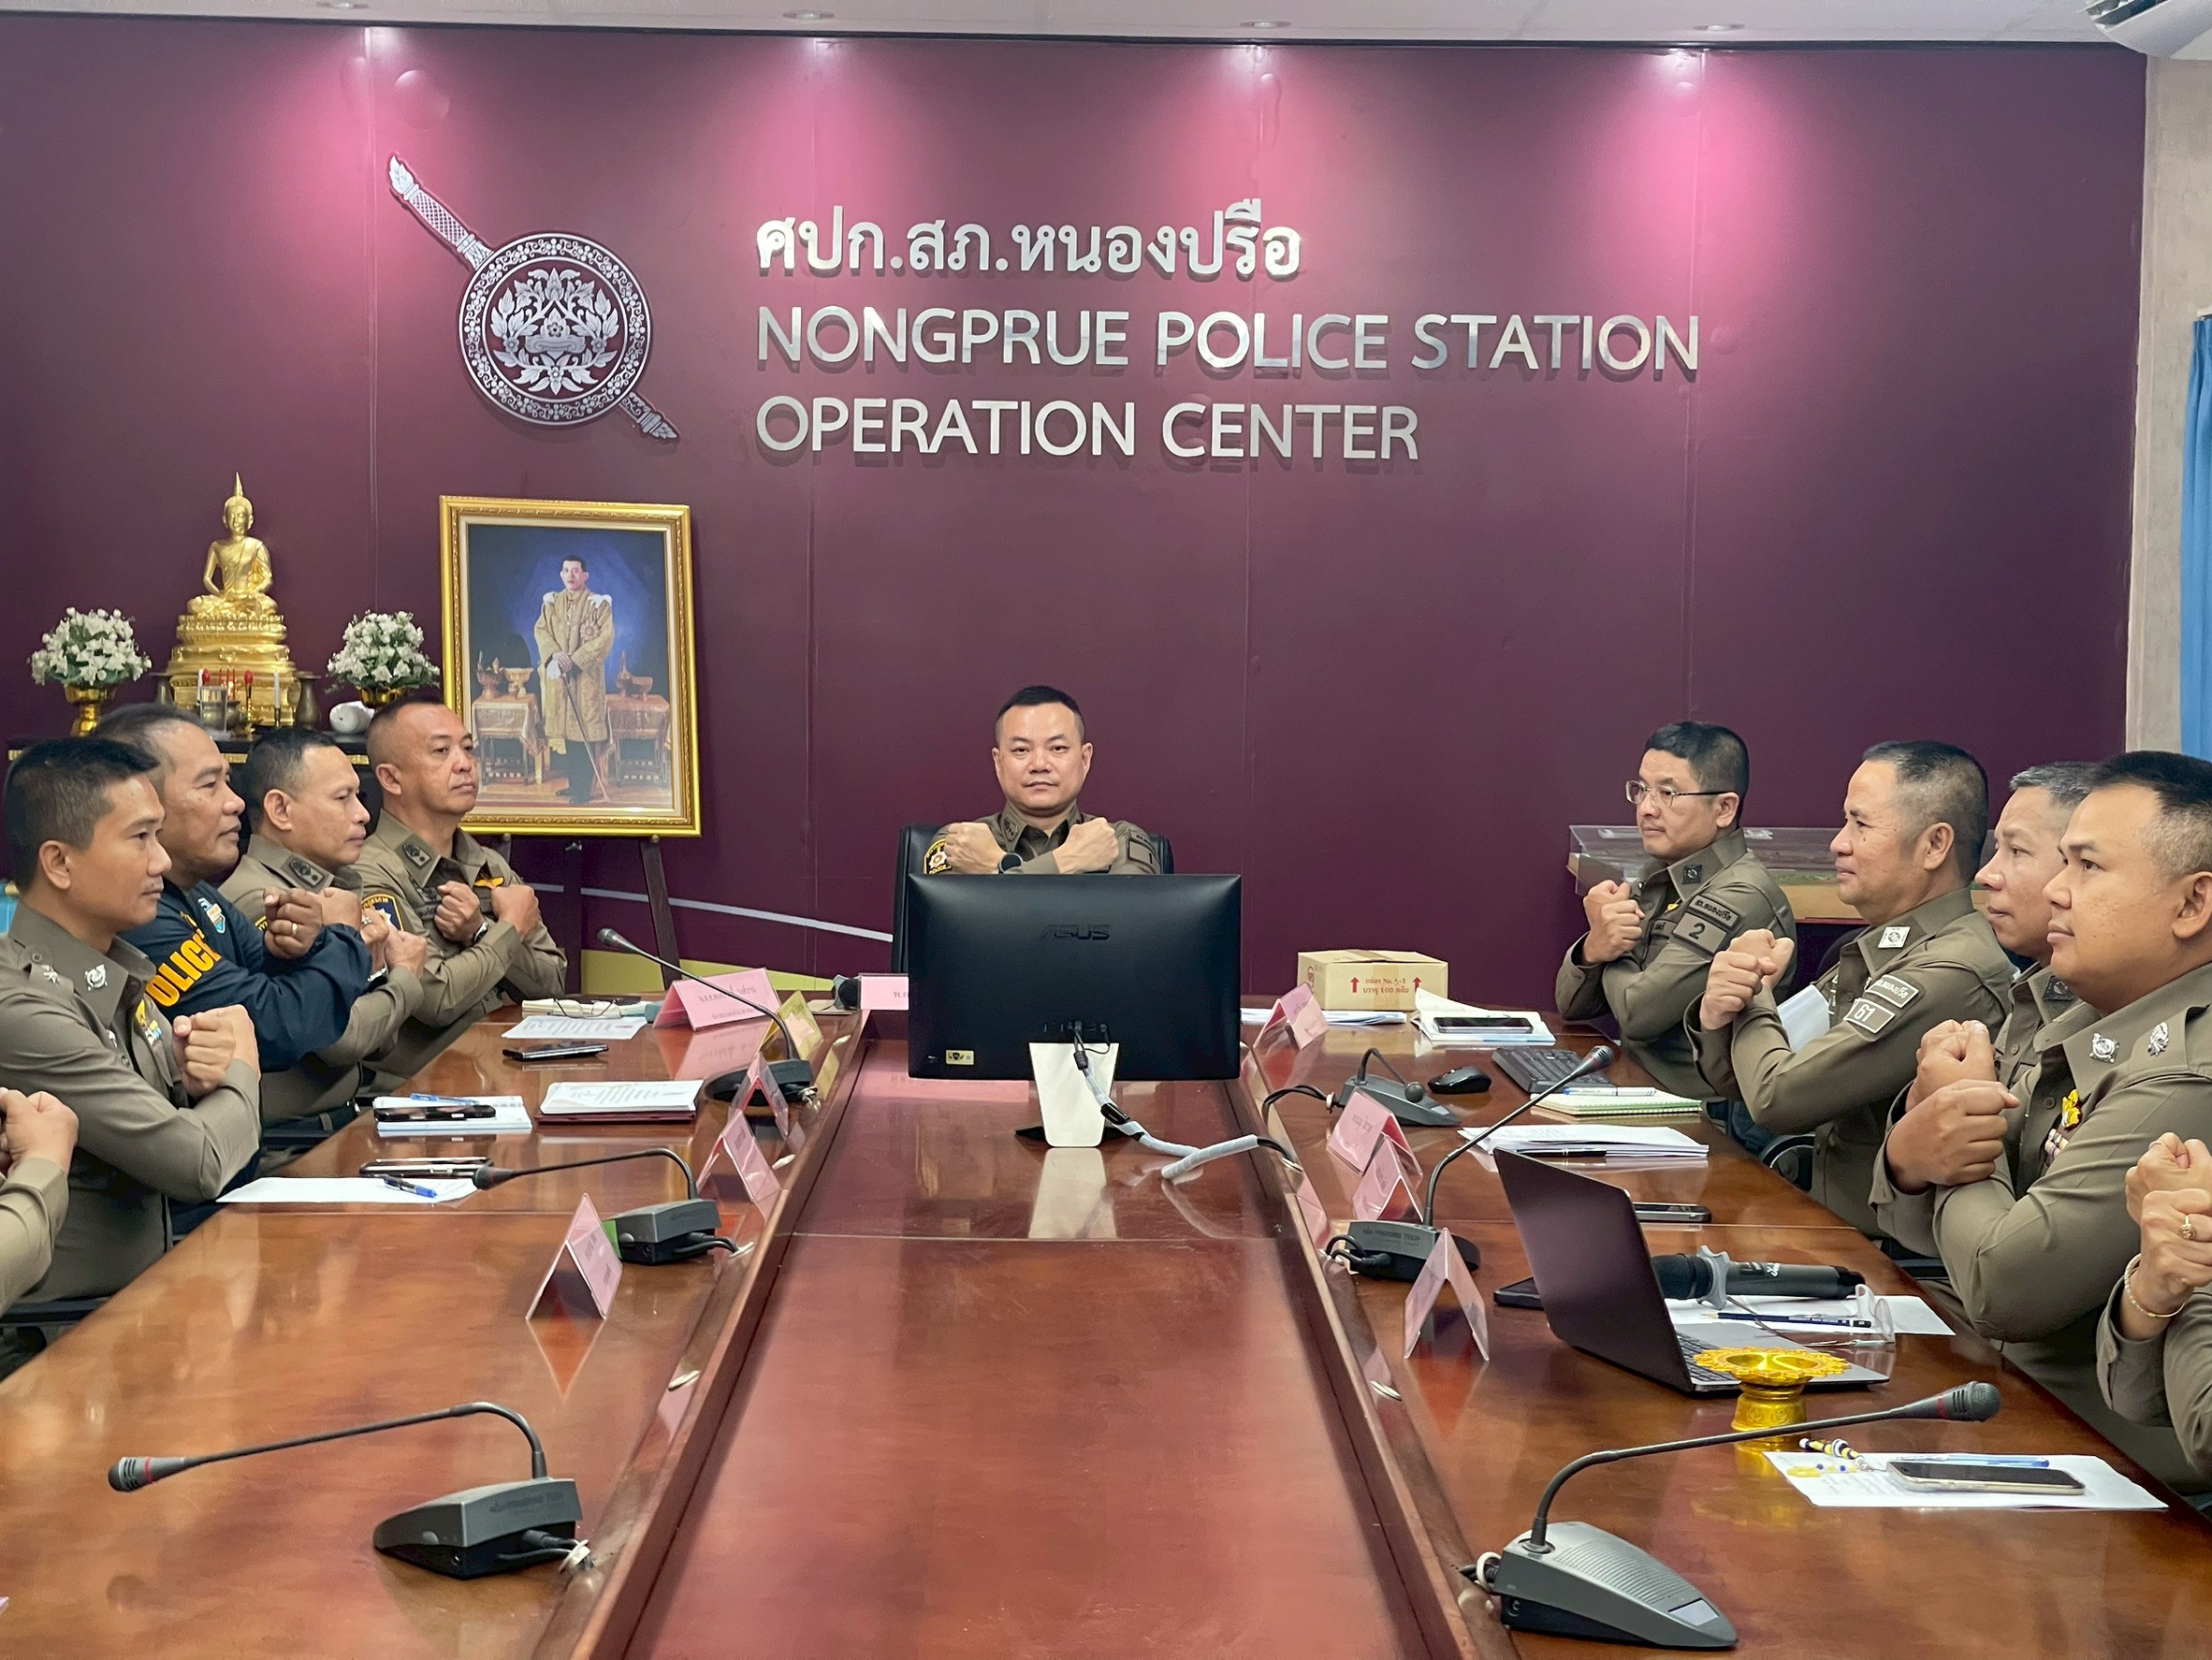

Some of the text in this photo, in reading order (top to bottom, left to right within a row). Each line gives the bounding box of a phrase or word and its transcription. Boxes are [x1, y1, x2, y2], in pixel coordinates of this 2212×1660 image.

[756, 197, 1301, 278] ศปก.สภ.หนองปรือ
[757, 306, 1699, 371] NONGPRUE POLICE STATION
[756, 395, 1419, 461] OPERATION CENTER
[1040, 924, 1112, 940] ASUS
[1688, 922, 1706, 940] 2
[1854, 1003, 1876, 1023] 61
